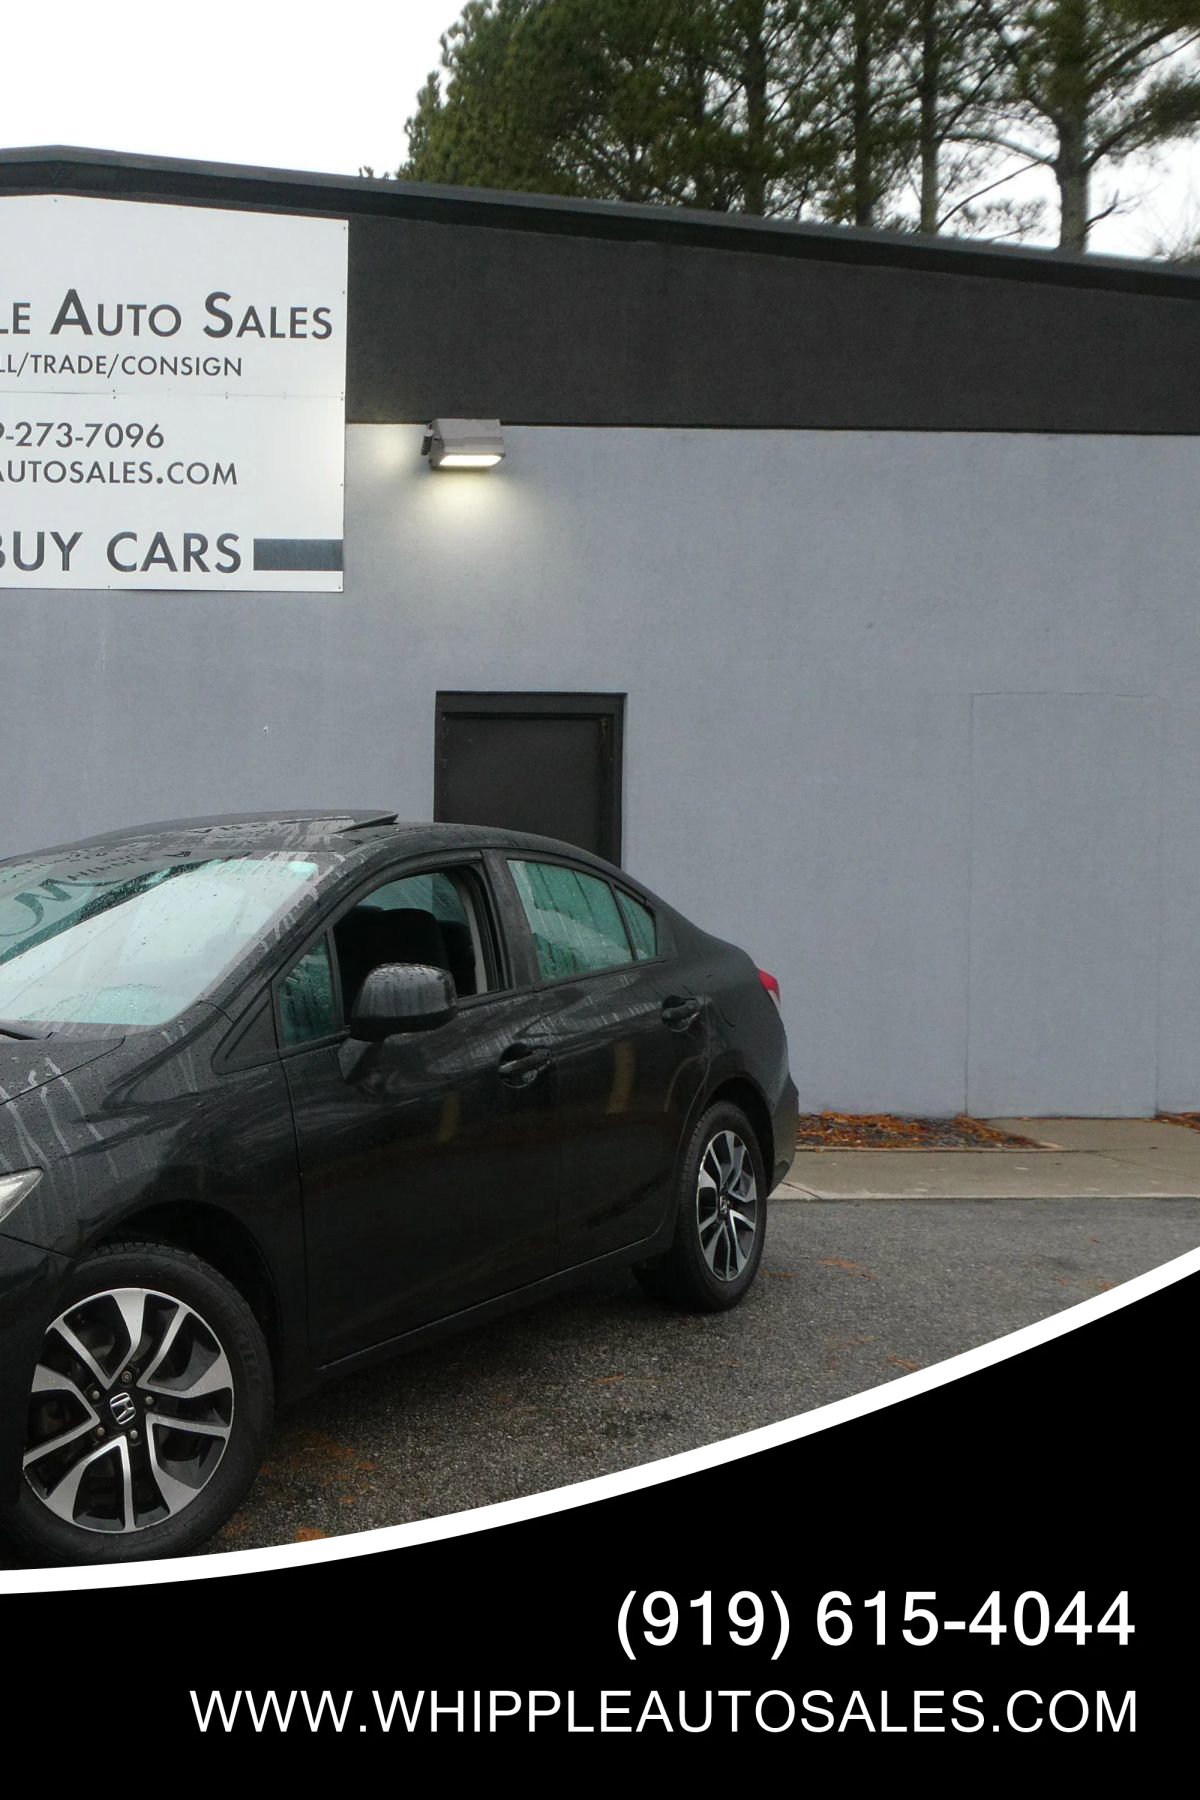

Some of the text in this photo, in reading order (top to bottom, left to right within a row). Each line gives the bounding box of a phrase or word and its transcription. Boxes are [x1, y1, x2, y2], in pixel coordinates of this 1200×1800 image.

[50, 288, 182, 337] AUTO
[203, 291, 333, 340] SALES
[106, 531, 242, 574] CARS
